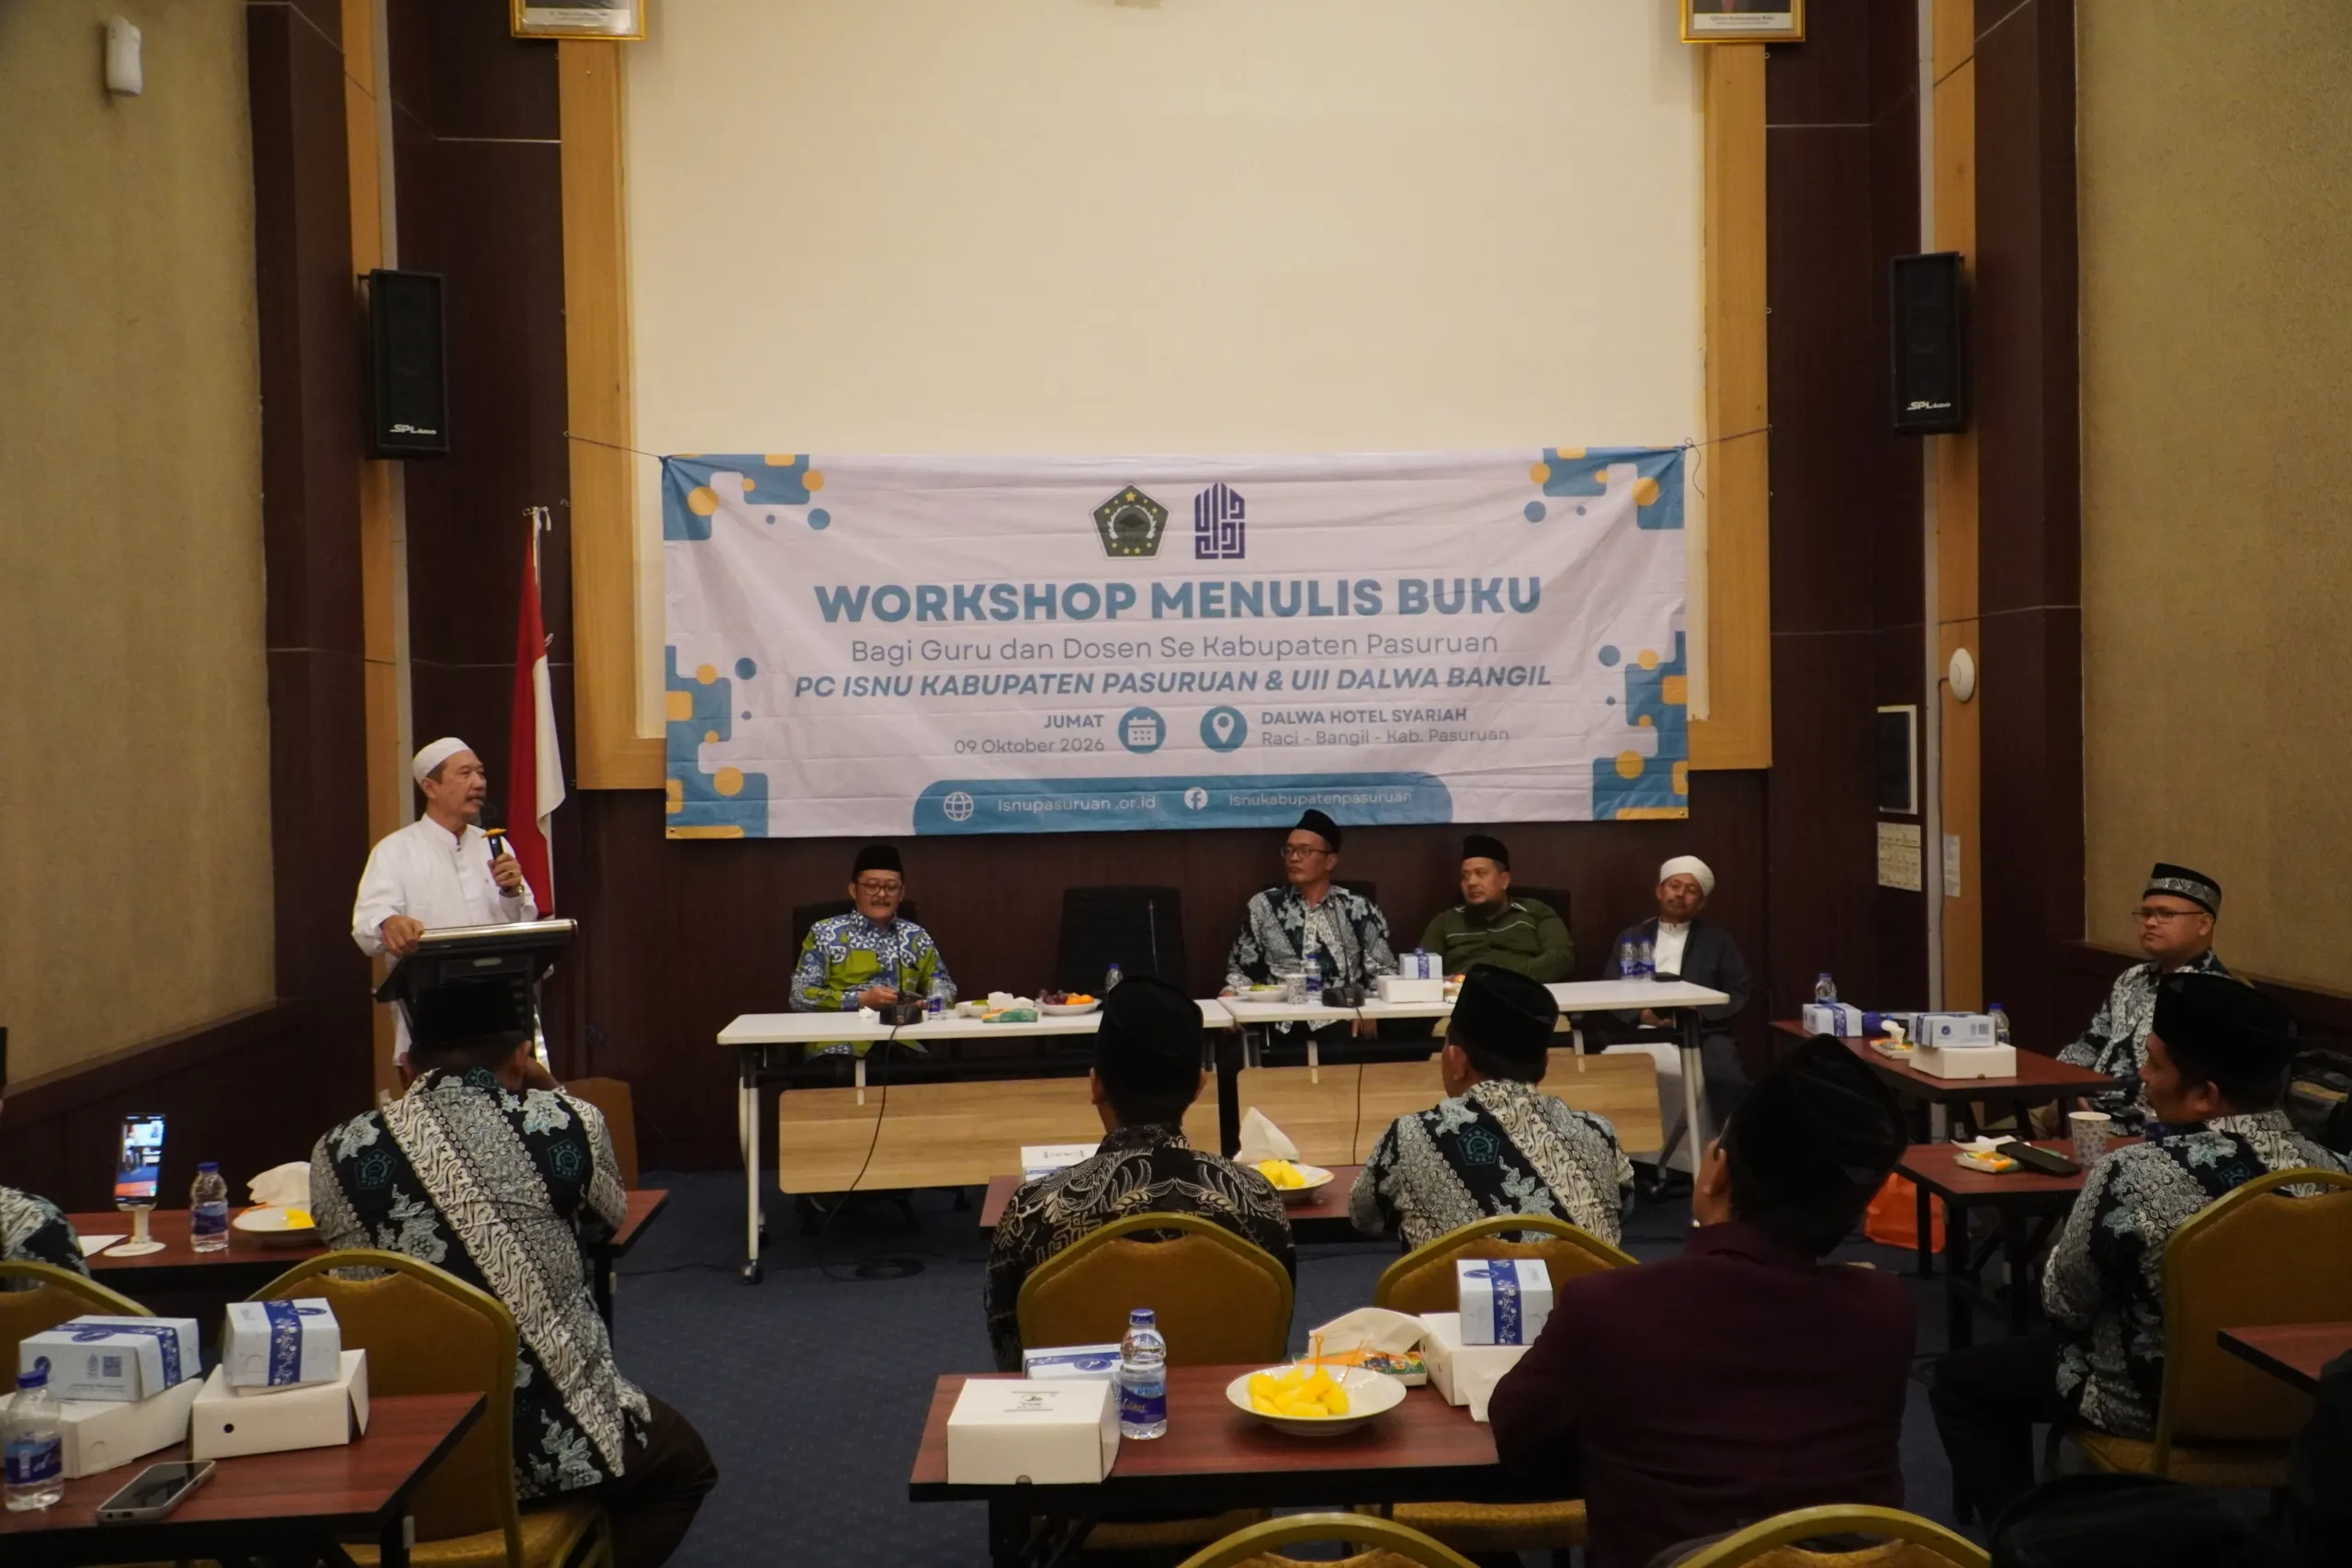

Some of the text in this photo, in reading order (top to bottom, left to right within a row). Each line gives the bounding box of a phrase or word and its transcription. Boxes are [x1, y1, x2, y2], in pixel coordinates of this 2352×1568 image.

[814, 576, 1542, 623] WORKSHOP MENULIS BUKU
[852, 634, 1498, 667] Bagi Guru dan Dosen Se Kabupaten Pasuruan
[795, 665, 1553, 698] PC ISNU KABUPATEN PASURUAN & UII DALWA BANGIL
[1044, 714, 1104, 729] JUMAT
[1261, 708, 1467, 726] DALWA HOTEL SYARIAH
[954, 738, 1105, 754] 09 Oktober 2026
[1261, 731, 1300, 747] Raci
[1317, 729, 1370, 747] Bangil
[1386, 729, 1423, 744] Kab.
[1429, 728, 1510, 743] Pasuruan
